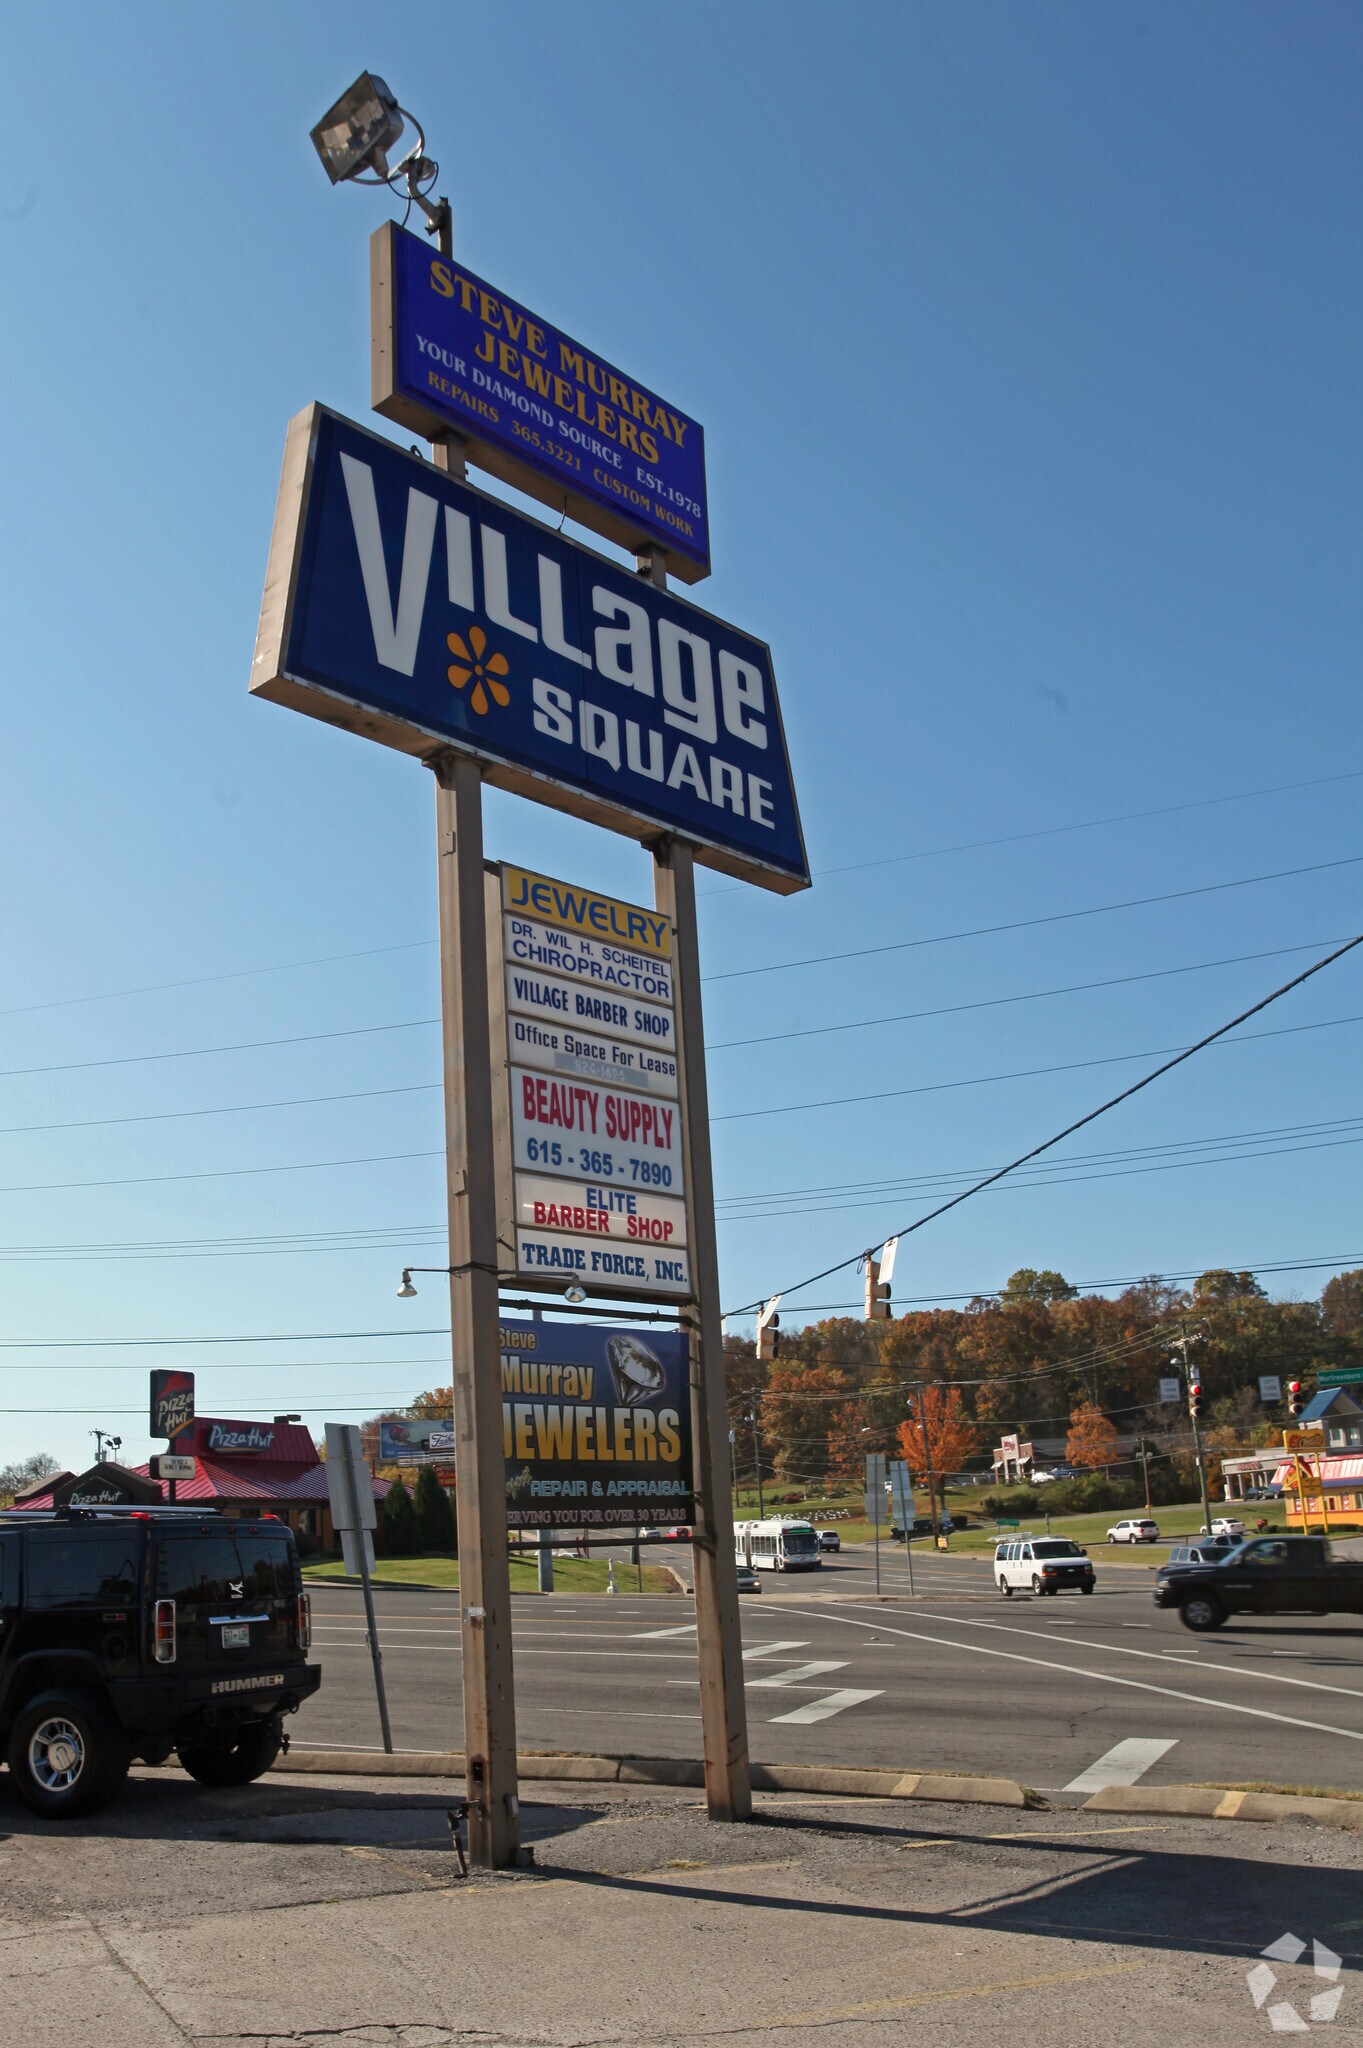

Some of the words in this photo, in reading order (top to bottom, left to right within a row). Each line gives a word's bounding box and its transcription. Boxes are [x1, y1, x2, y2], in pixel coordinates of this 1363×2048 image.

[430, 260, 547, 359] STEVE
[558, 341, 687, 448] MURRAY
[474, 330, 659, 464] JEWELERS
[416, 334, 467, 377] YOUR
[473, 367, 554, 428] DIAMOND
[558, 420, 623, 469] SOURCE
[636, 467, 702, 518] EST.1978
[428, 371, 500, 423] REPAIRS
[511, 420, 582, 471] 365.3221
[593, 467, 650, 512] CUSTOM
[654, 502, 694, 538] WORK
[532, 677, 775, 830] SQUARE
[511, 877, 667, 947] JEWELRY
[512, 921, 536, 940] DR.
[545, 931, 572, 950] WIL
[580, 941, 594, 956] H.
[602, 948, 669, 978] SCHEITEL
[513, 940, 669, 998] CHIROPRACTOR
[514, 977, 569, 1011] VILLAGE
[575, 994, 628, 1027] BARBER
[635, 1010, 670, 1037] SHOP
[515, 1022, 558, 1049] Office
[564, 1035, 606, 1061] Space
[612, 1046, 634, 1066] For
[639, 1052, 676, 1076] Lease
[522, 1075, 599, 1135] BEAUTY
[605, 1095, 673, 1150] SUPPLY
[534, 1201, 609, 1232] BARBER
[627, 1215, 673, 1241] SHOP
[586, 1187, 637, 1214] ELITE
[522, 1243, 586, 1271] TRADE
[591, 1251, 650, 1282] FORCE,
[655, 1259, 688, 1283] INC.
[499, 1327, 536, 1350] Steve
[500, 1355, 594, 1401] Murray
[158, 1392, 195, 1427] Pizza
[165, 1406, 191, 1433] Hut
[502, 1402, 681, 1462] JEWELERS
[209, 1424, 246, 1447] Pizza
[247, 1427, 275, 1447] Hut
[69, 1492, 98, 1505] Pizza
[98, 1489, 123, 1502] Hut
[530, 1480, 588, 1497] REPAIR
[591, 1480, 604, 1497] &
[606, 1480, 691, 1497] APPRAISAL
[506, 1510, 551, 1524] ERVING
[552, 1509, 578, 1523] YOU
[580, 1509, 604, 1523] FOR
[604, 1509, 636, 1523] OVER
[637, 1508, 649, 1522] 30
[650, 1508, 687, 1521] YEARS
[211, 1674, 284, 1693] HUMMER
